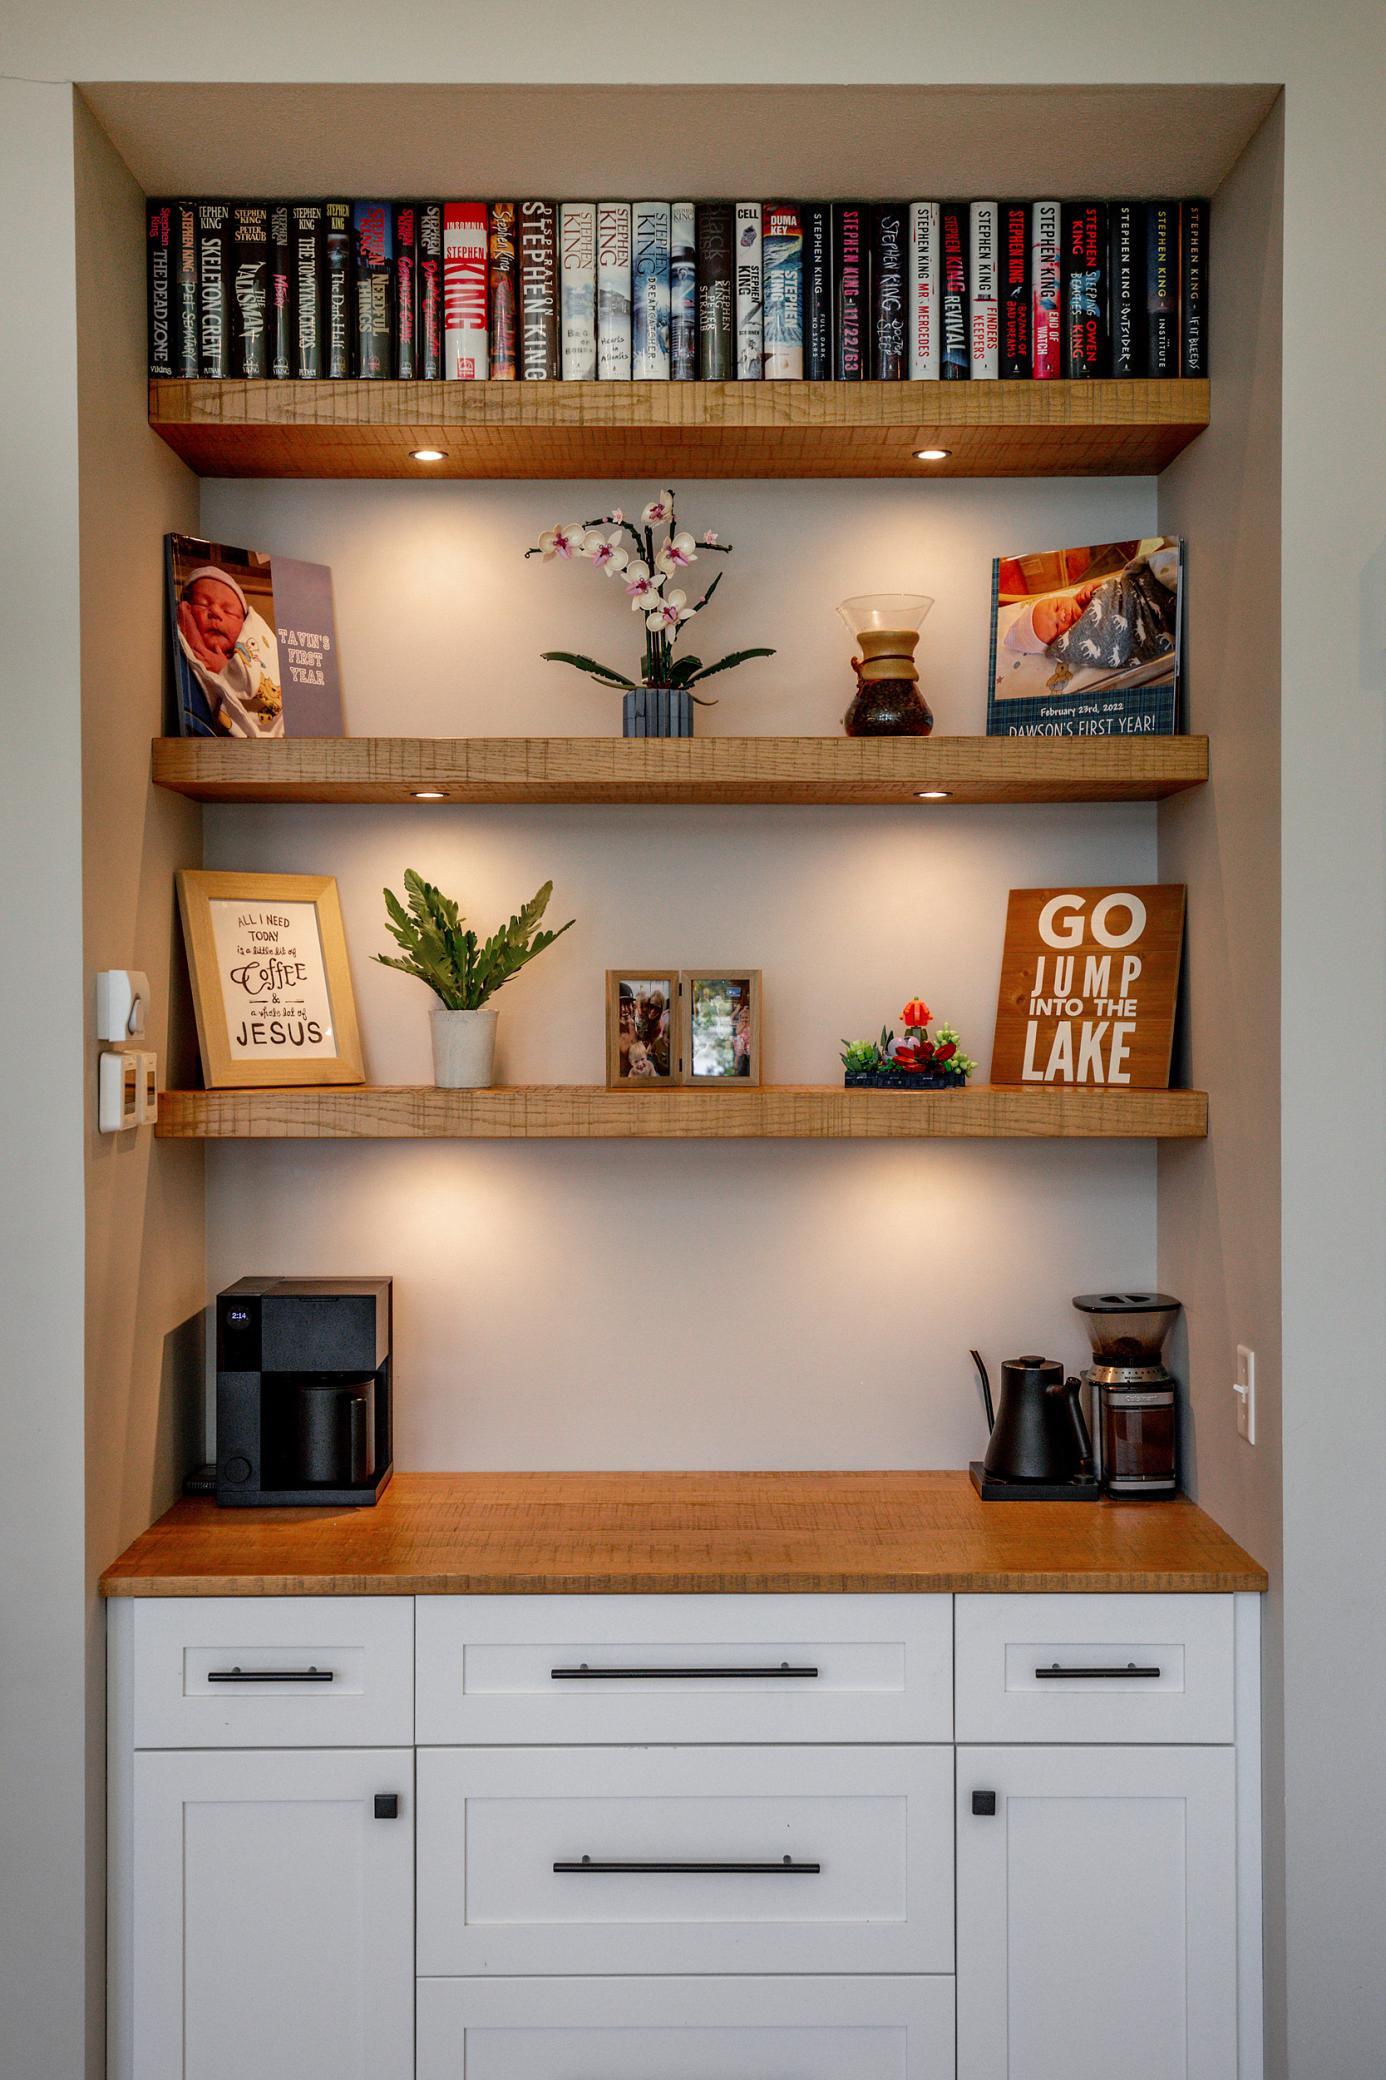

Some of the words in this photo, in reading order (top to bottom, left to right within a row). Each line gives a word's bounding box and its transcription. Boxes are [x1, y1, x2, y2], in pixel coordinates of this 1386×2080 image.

[201, 218, 222, 229] KING
[234, 209, 267, 220] STEPHEN
[240, 216, 261, 224] KING
[271, 214, 280, 240] KING
[276, 207, 288, 246] STEPHEN
[293, 208, 321, 219] STEPHEN
[299, 219, 315, 230] KING
[326, 204, 350, 217] STEPHEN
[331, 217, 345, 230] KING
[446, 221, 484, 230] INSOMNIA
[738, 209, 759, 219] CELL
[771, 215, 797, 226] DUMA
[182, 212, 194, 248] STEPHEN
[235, 230, 267, 241] STRAUB
[240, 226, 262, 234] PETER
[298, 236, 316, 260] THE
[420, 215, 430, 248] KING
[427, 206, 440, 256] STEPHEN
[492, 211, 513, 249] Stephen
[564, 213, 581, 270] KING
[580, 212, 592, 270] STEPHEN
[600, 210, 617, 267] KING
[617, 208, 629, 268] STEPHEN
[637, 214, 657, 275] KING
[656, 212, 668, 275] STEPHEN
[771, 226, 788, 235] KEY
[813, 213, 822, 263] STEPHEN
[843, 210, 859, 262] STEPHEN
[880, 215, 900, 269] STEPHEN
[918, 208, 929, 253] STEPHEN
[944, 215, 961, 253] STEPHEN
[978, 211, 991, 260] STEPHEN
[1008, 210, 1024, 260] STEPHEN
[1040, 207, 1056, 263] STEPHEN
[1072, 220, 1084, 255] KING
[1085, 208, 1097, 267] STEPHEN
[1121, 207, 1130, 262] STEPHEN
[1157, 211, 1166, 262] STEPHEN
[1190, 207, 1199, 262] STEPHEN
[183, 250, 194, 272] KING
[446, 246, 484, 260] STEPHEN
[492, 249, 515, 271] King
[522, 201, 547, 313] STEPHEN
[543, 208, 554, 316] DESPERATION
[918, 255, 929, 279] KING
[202, 238, 222, 311] SKELETON
[738, 266, 751, 296] KING
[750, 265, 760, 304] STEPHEN
[771, 270, 784, 302] KING
[814, 267, 823, 294] KING
[843, 267, 859, 296] KING
[945, 256, 966, 293] KING
[978, 264, 991, 291] KING
[1008, 260, 1024, 284] KING
[1040, 265, 1056, 298] KING
[1121, 267, 1130, 299] KING
[1157, 267, 1167, 298] KING
[1190, 268, 1199, 300] KING
[154, 280, 168, 319] DEAD
[357, 279, 372, 333] THINGS
[372, 274, 389, 336] NEEDFUL
[444, 258, 486, 330] KING
[715, 280, 724, 308] KING
[722, 280, 731, 332] STEPHEN
[784, 270, 798, 328] STEPHEN
[880, 273, 901, 311] KING
[1070, 272, 1082, 316] BEAUTIES
[1085, 271, 1096, 316] SLEEPING
[647, 277, 656, 359] DREAMCATCHER
[707, 295, 716, 330] PETER
[944, 295, 966, 353] REVIVAL
[987, 307, 998, 349] FINDERS
[1048, 311, 1059, 328] END
[154, 321, 168, 361] ZONE
[202, 314, 221, 358] CREW
[843, 308, 859, 371] 11/22/63
[918, 305, 930, 358] MERCEDES
[973, 315, 985, 360] KEEPERS
[1037, 325, 1048, 355] WATCH
[1048, 331, 1059, 342] OF
[1072, 324, 1084, 359] KING
[1085, 321, 1097, 362] OWEN
[1119, 307, 1131, 362] OUTSIDER
[1158, 318, 1166, 367] INSTITUTE
[524, 324, 547, 380] KING
[1188, 337, 1200, 369] BLEEDS
[278, 628, 330, 650] TAVIN'S
[288, 648, 323, 667] FIRST
[290, 666, 325, 686] YEAR
[1009, 722, 1073, 736] DAWSON'S
[1079, 719, 1114, 736] FIRST
[1118, 714, 1155, 733] YEAR!
[1040, 707, 1076, 717] February
[1103, 702, 1124, 712] 2022
[238, 914, 257, 928] ALL
[259, 913, 263, 925] I
[266, 914, 290, 928] NEED
[248, 931, 279, 942] TODAY
[1038, 892, 1147, 949] GO
[1031, 955, 1142, 998] JUMP
[271, 992, 281, 1004] &
[1029, 998, 1083, 1016] INTO
[1094, 999, 1137, 1016] THE
[237, 1021, 323, 1046] JESUS
[1022, 1020, 1136, 1084] LAKE
[231, 1312, 247, 1320] 2:14
